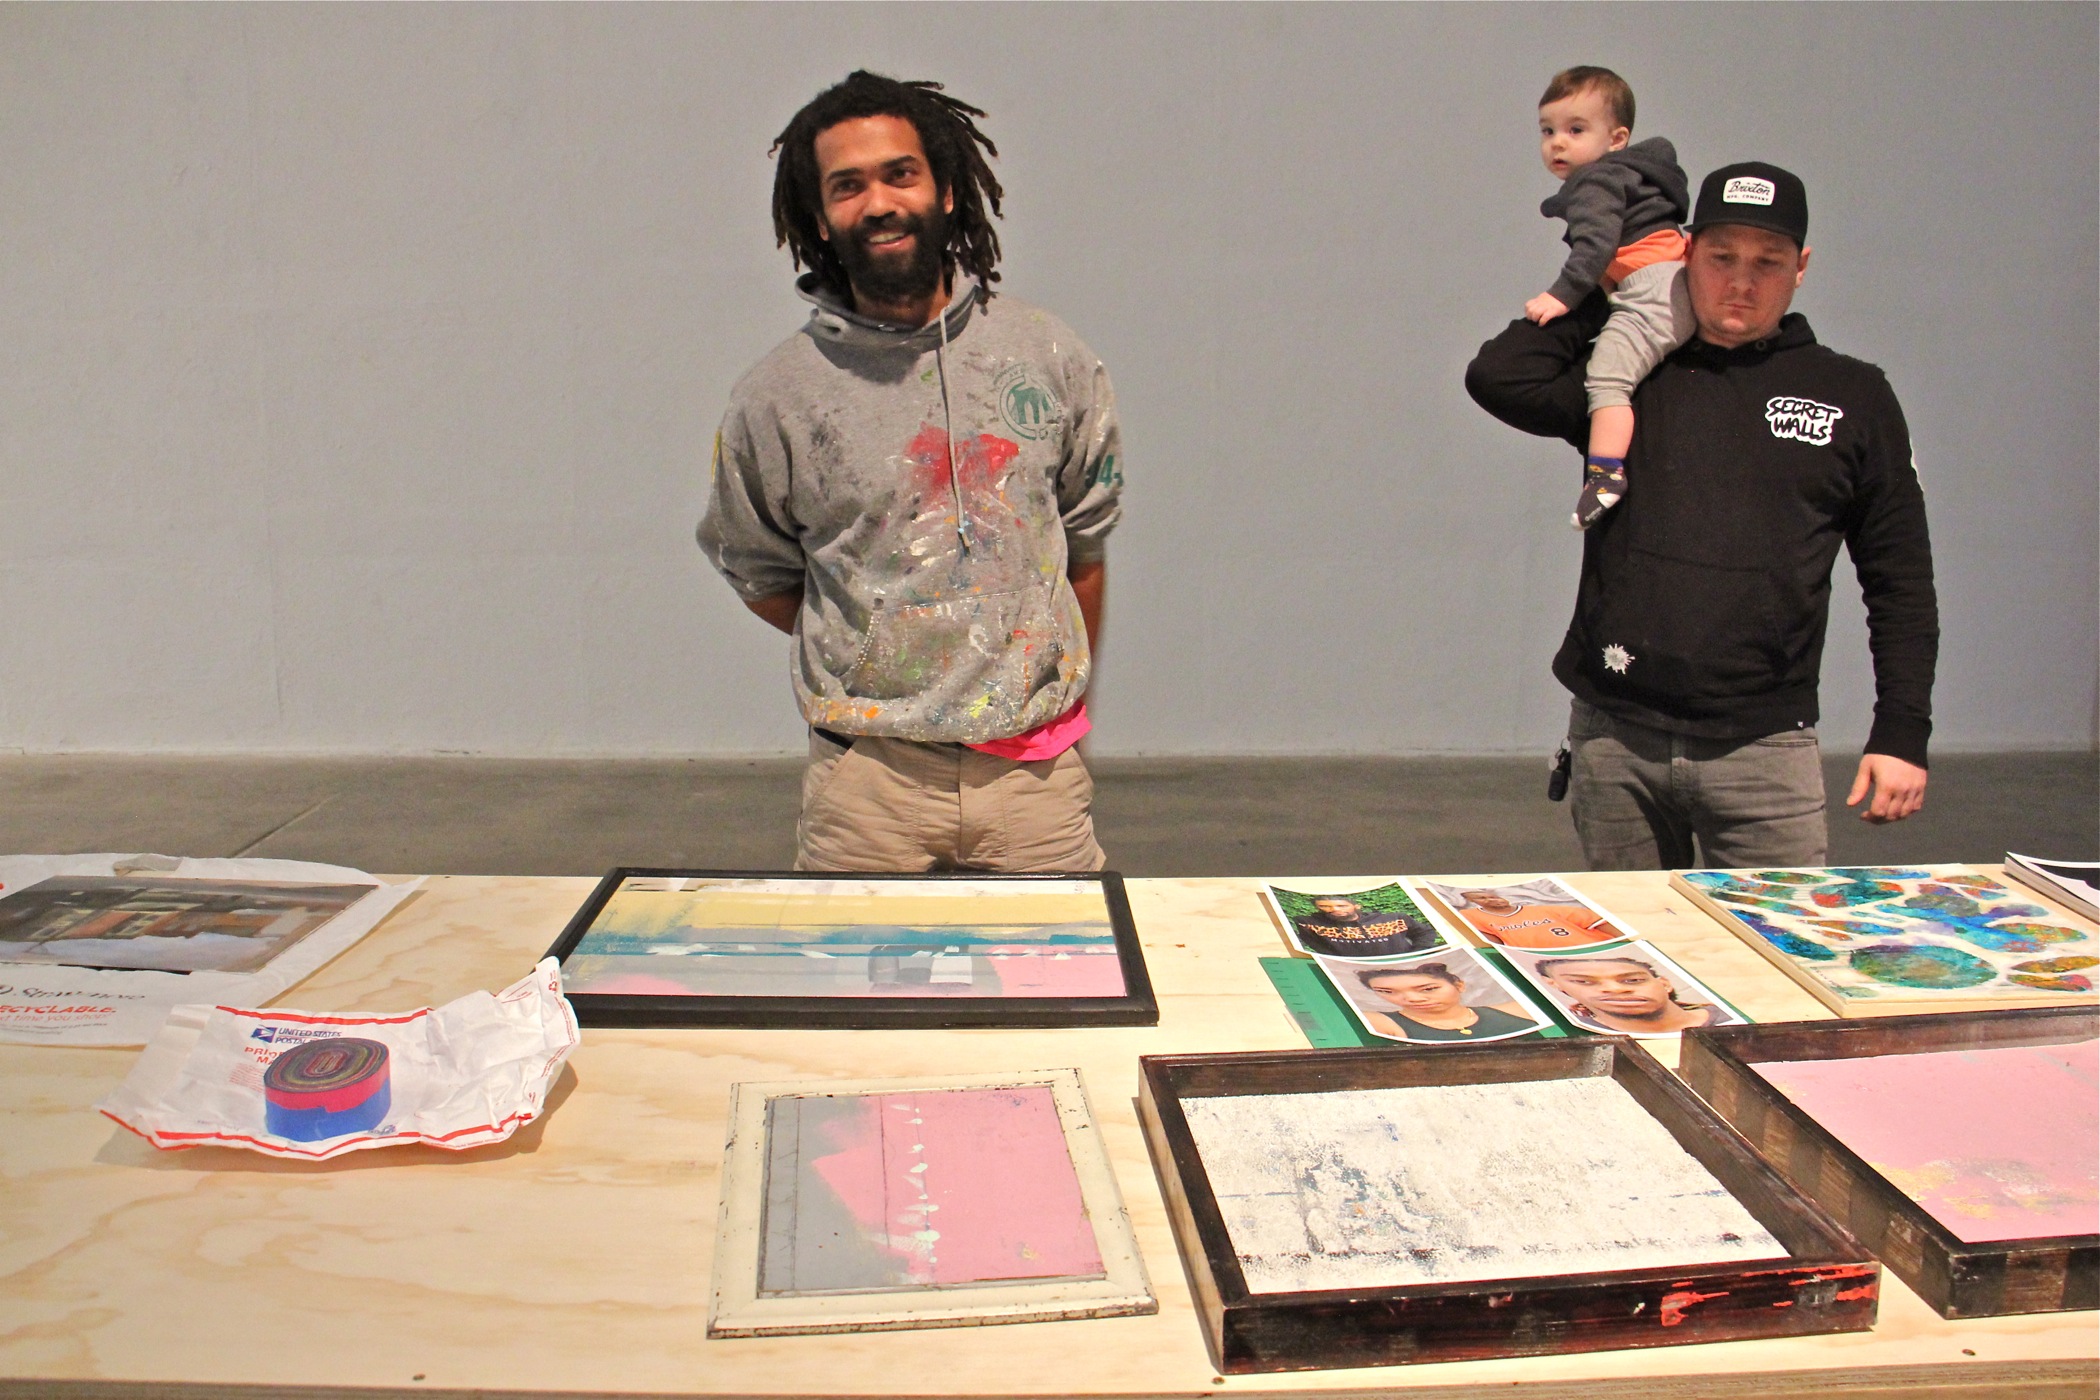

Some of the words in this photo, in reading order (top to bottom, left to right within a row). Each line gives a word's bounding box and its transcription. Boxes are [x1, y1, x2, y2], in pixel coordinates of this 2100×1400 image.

[1728, 180, 1771, 196] Brixton
[1767, 398, 1840, 423] SECRET
[1773, 417, 1829, 441] WALLS
[1550, 927, 1570, 937] 8
[278, 1028, 312, 1037] UNITED
[313, 1030, 342, 1038] STATES
